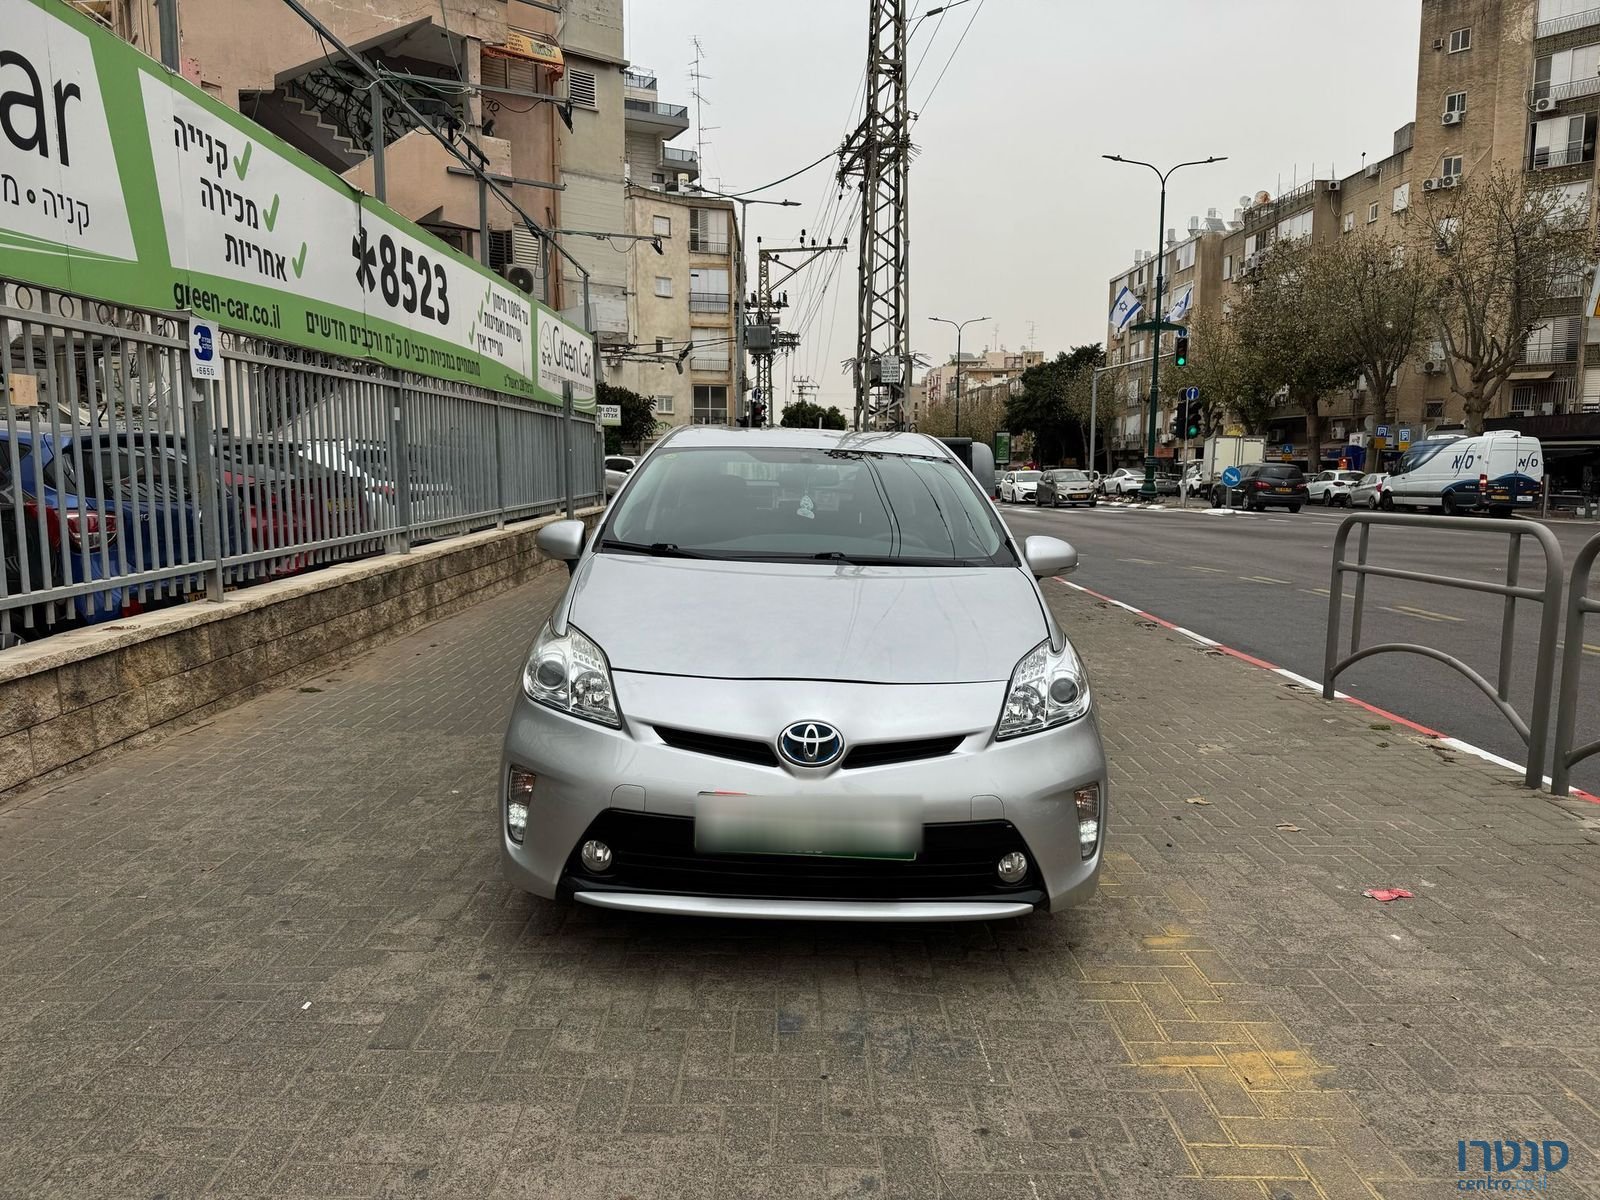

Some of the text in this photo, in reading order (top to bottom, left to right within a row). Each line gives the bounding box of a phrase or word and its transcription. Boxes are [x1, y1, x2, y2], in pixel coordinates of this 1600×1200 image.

[173, 115, 229, 178] קנייה
[42, 187, 90, 235] קניה
[200, 177, 259, 230] מכירה
[224, 233, 288, 282] אחריות
[173, 282, 281, 329] green-car.co.il
[305, 311, 347, 342] חדשים
[349, 324, 383, 352] ורכבים
[404, 338, 410, 360] 0
[411, 342, 430, 363] רכבי
[553, 325, 579, 374] Green
[579, 340, 592, 379] Car
